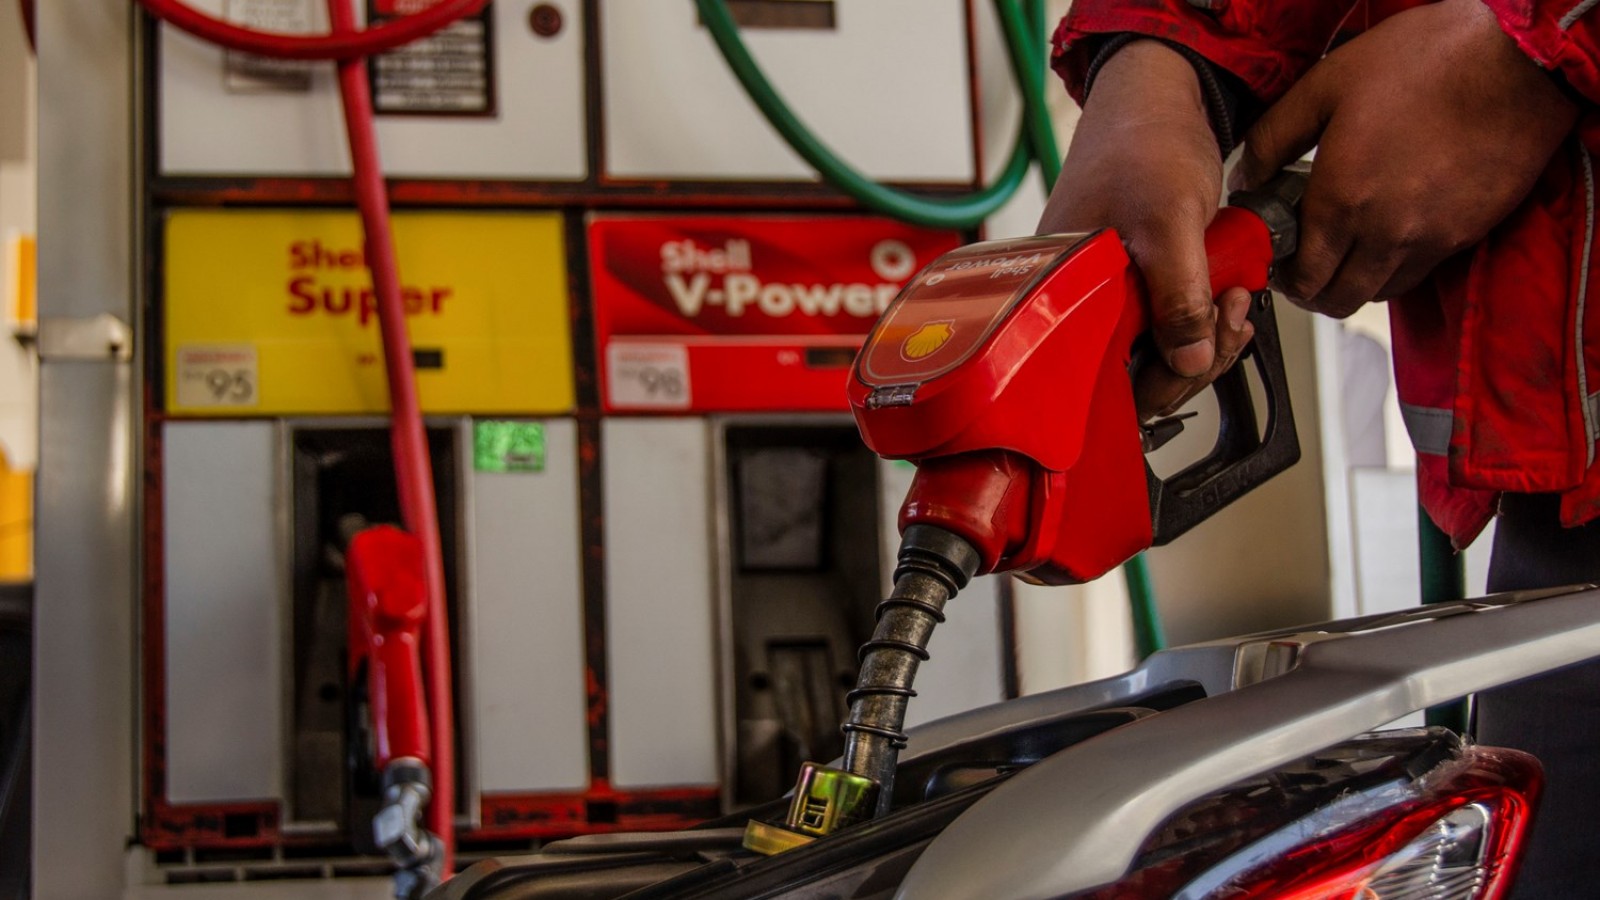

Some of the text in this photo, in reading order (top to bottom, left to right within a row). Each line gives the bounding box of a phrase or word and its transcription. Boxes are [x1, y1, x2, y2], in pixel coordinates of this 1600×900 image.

[660, 239, 752, 271] Shell
[663, 273, 900, 318] V-Power
[206, 368, 253, 403] 95
